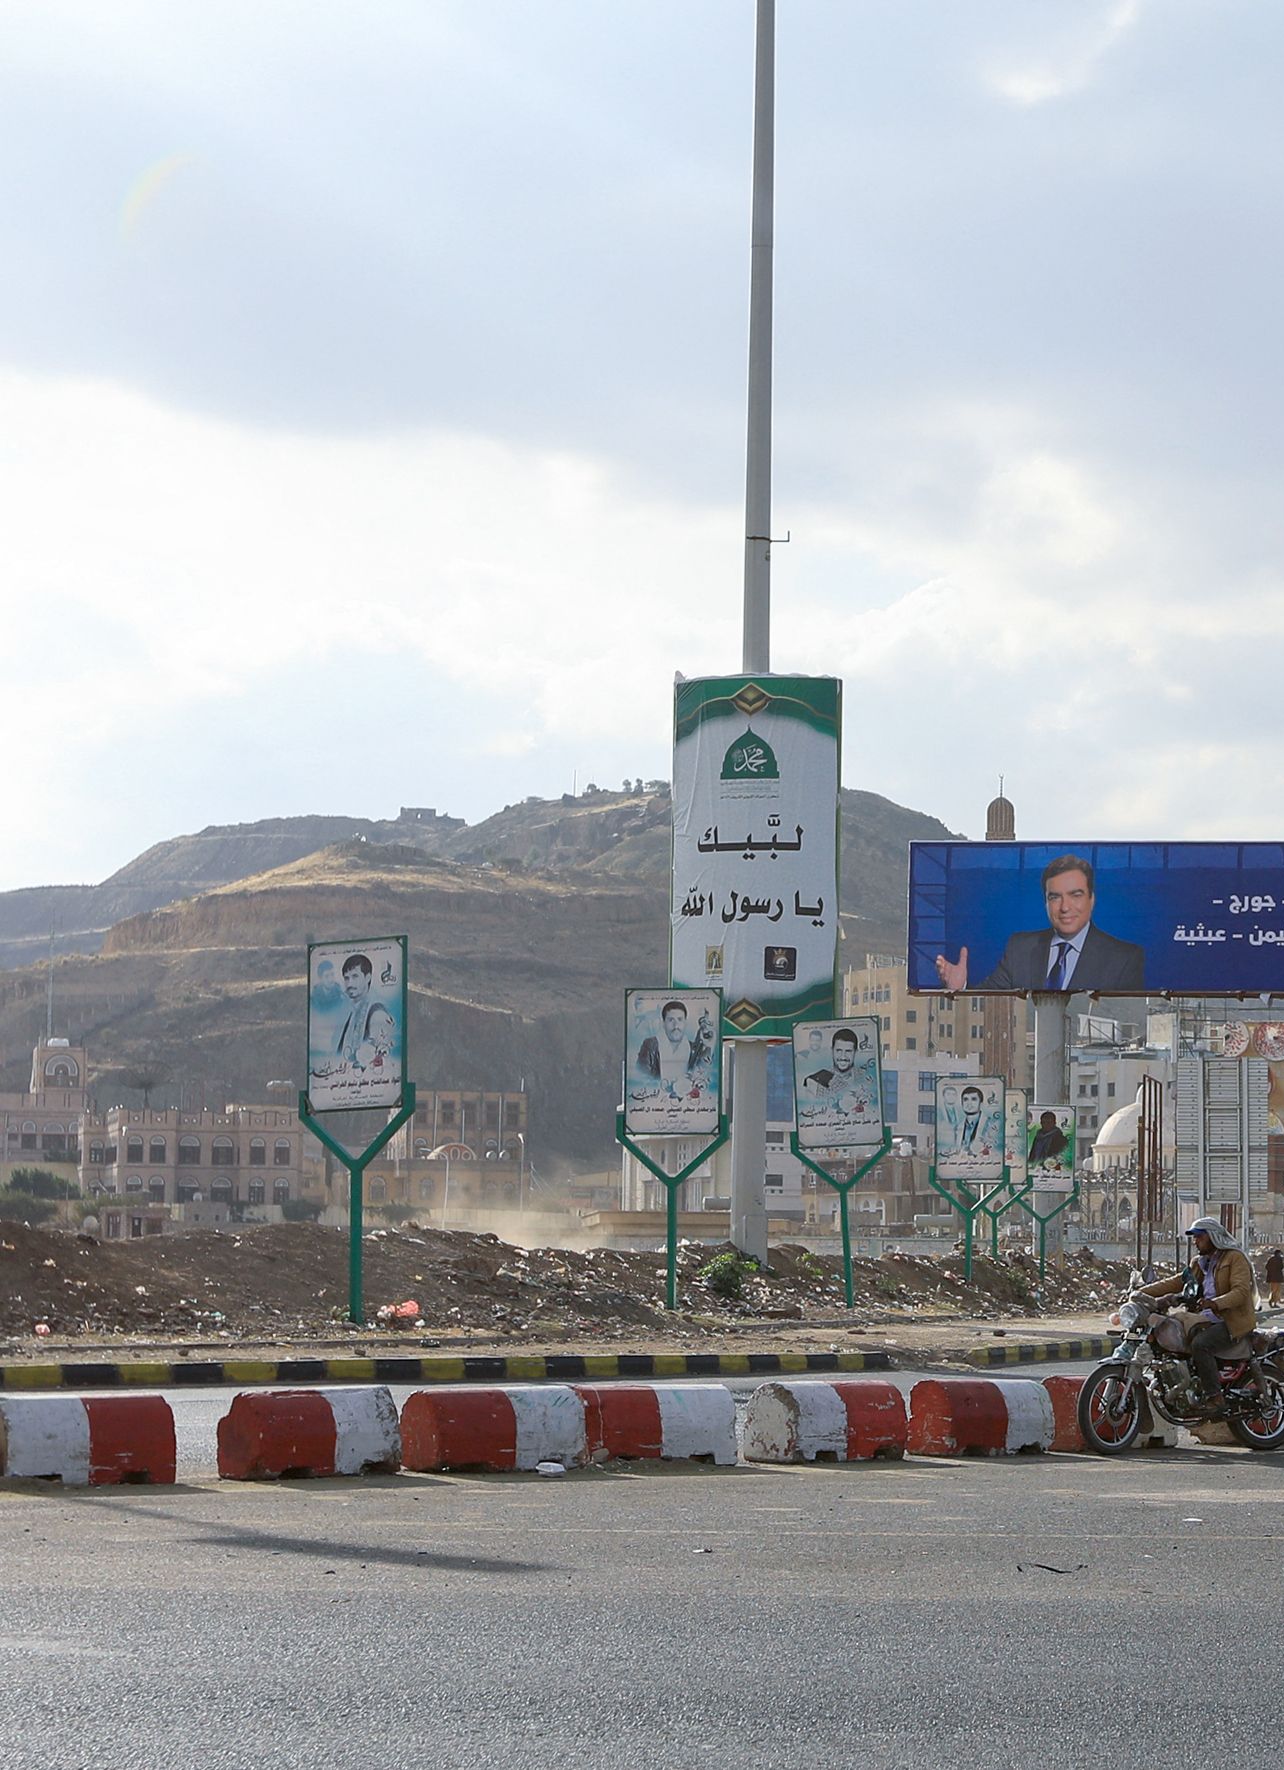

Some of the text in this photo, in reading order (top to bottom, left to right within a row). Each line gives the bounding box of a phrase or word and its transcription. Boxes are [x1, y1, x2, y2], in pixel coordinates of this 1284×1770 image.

[721, 889, 783, 923] رسول
[794, 889, 825, 927] يا
[1228, 894, 1276, 914] جورج
[1173, 923, 1226, 946] عبثية
